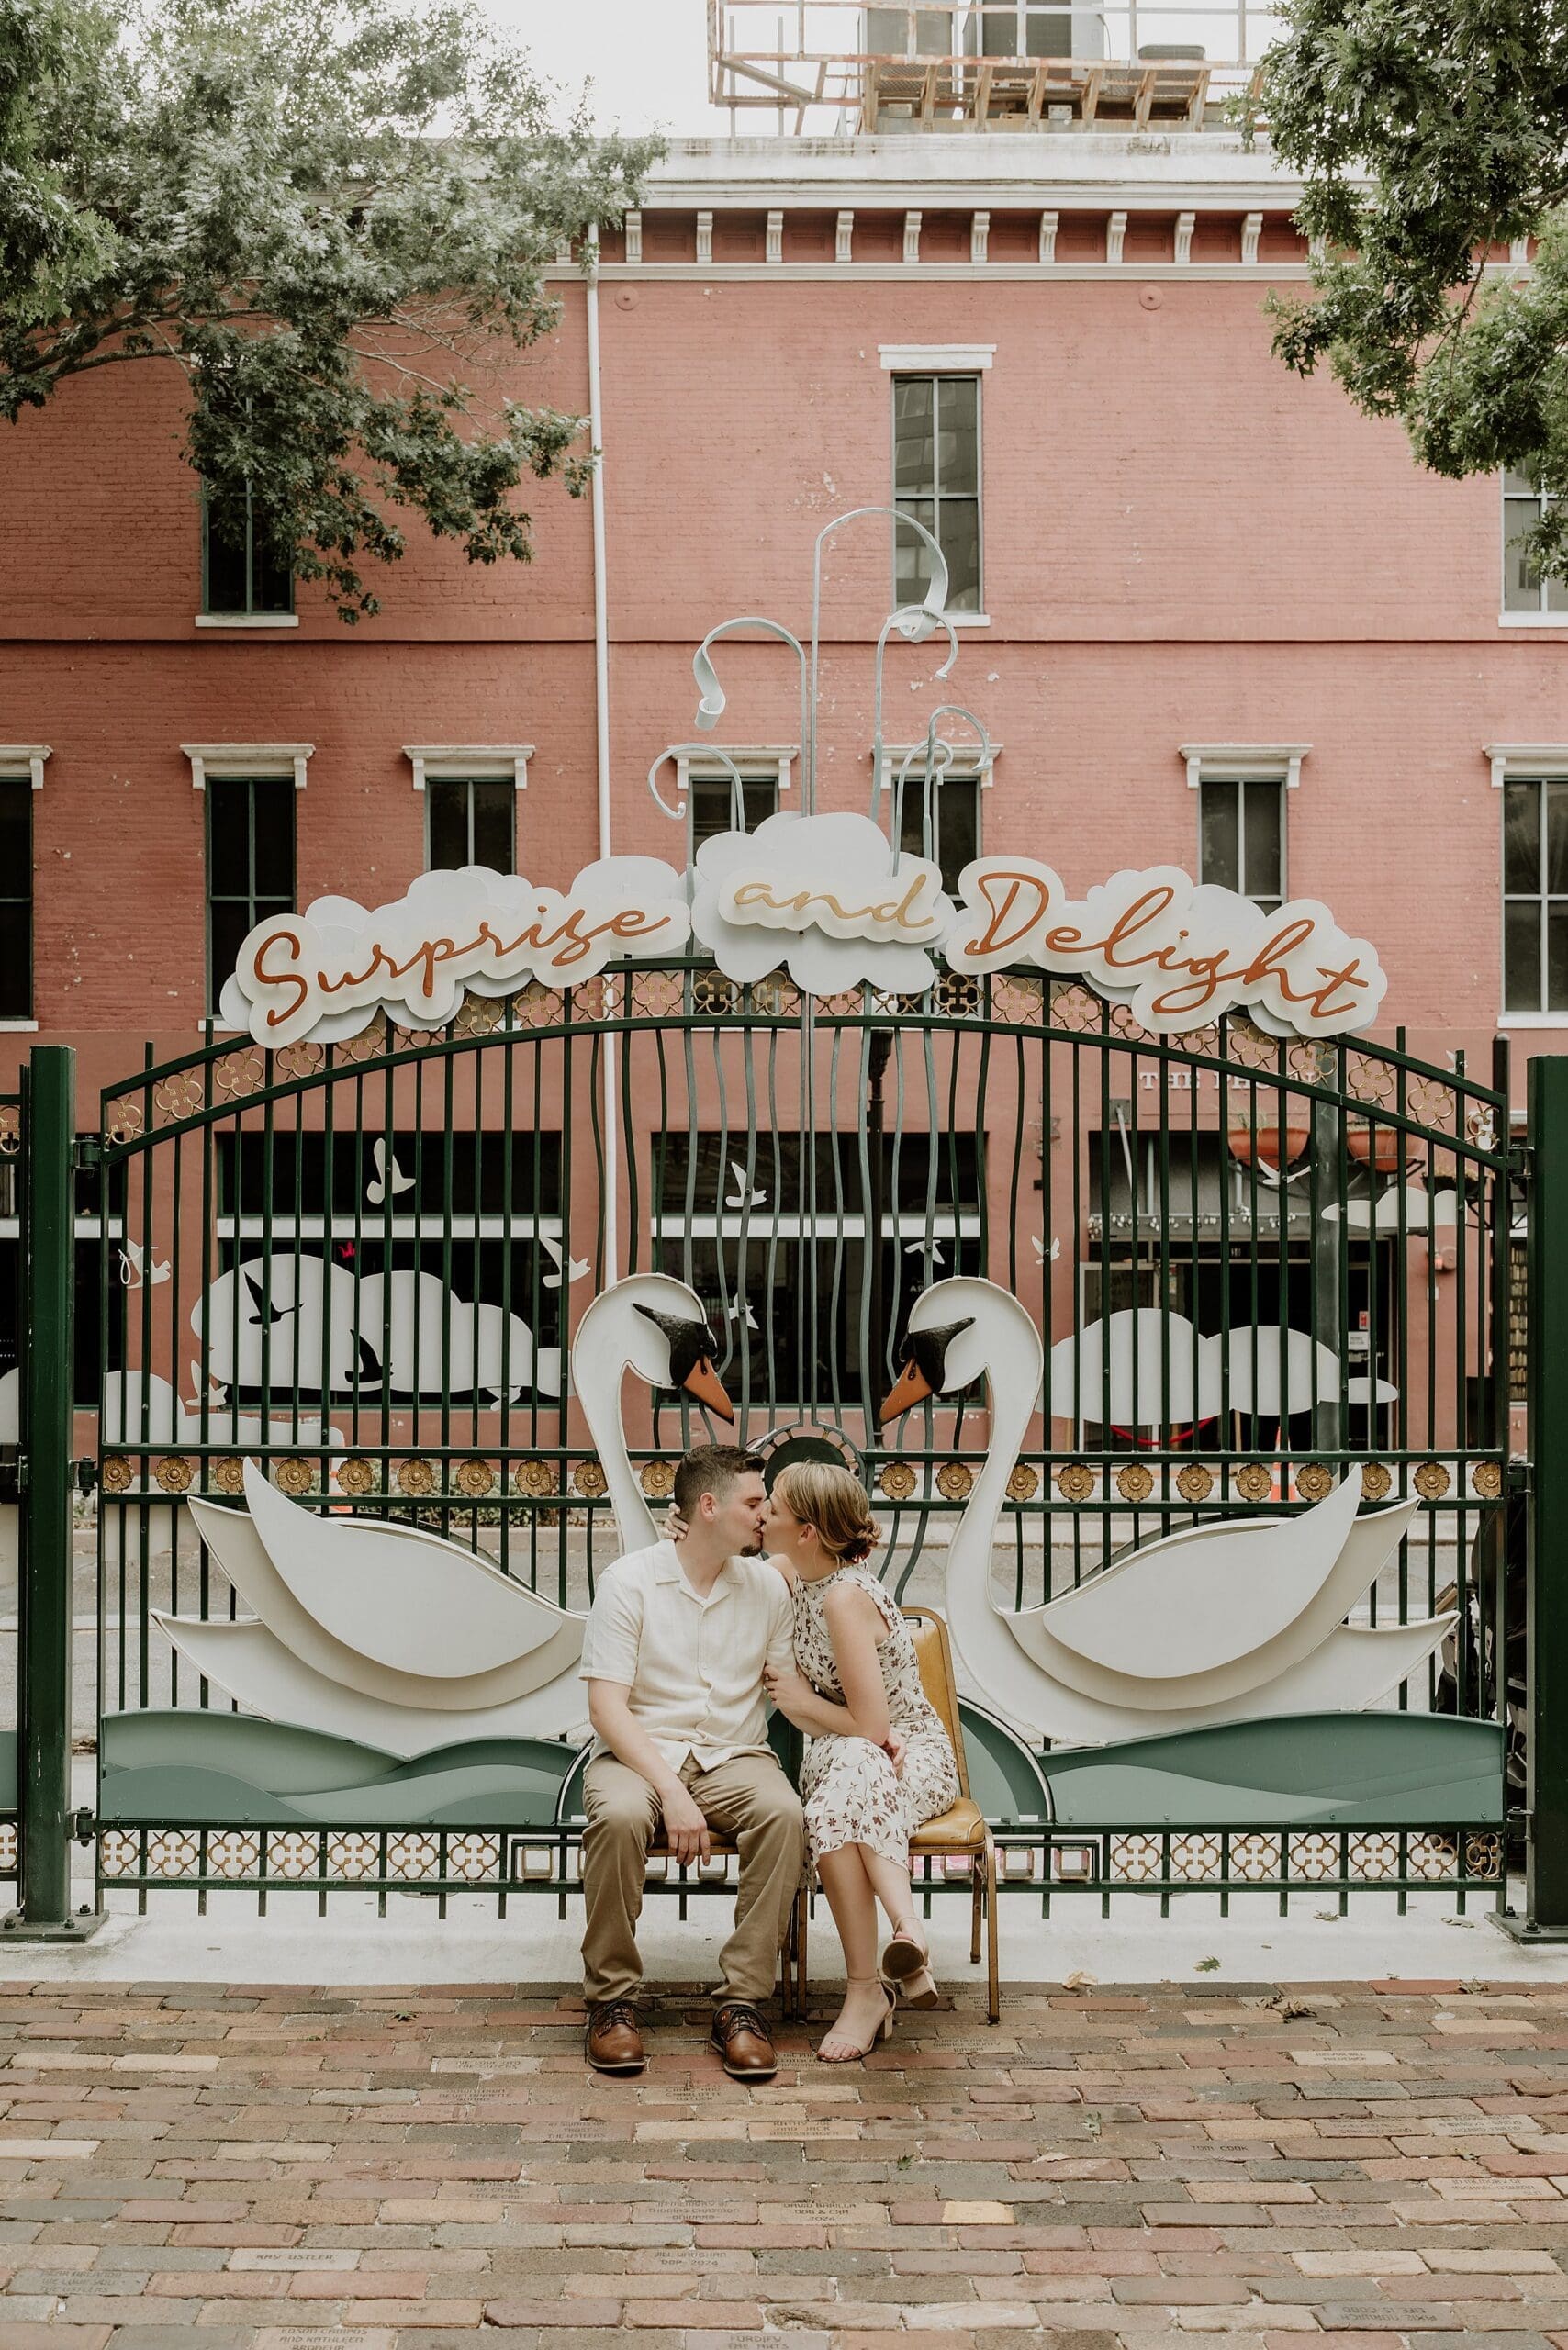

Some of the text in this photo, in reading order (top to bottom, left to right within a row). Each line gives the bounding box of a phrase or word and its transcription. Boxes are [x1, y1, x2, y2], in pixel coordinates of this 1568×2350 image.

[253, 872, 1369, 1027] Surprise and Delight
[256, 2253, 335, 2261] KAY USTLER
